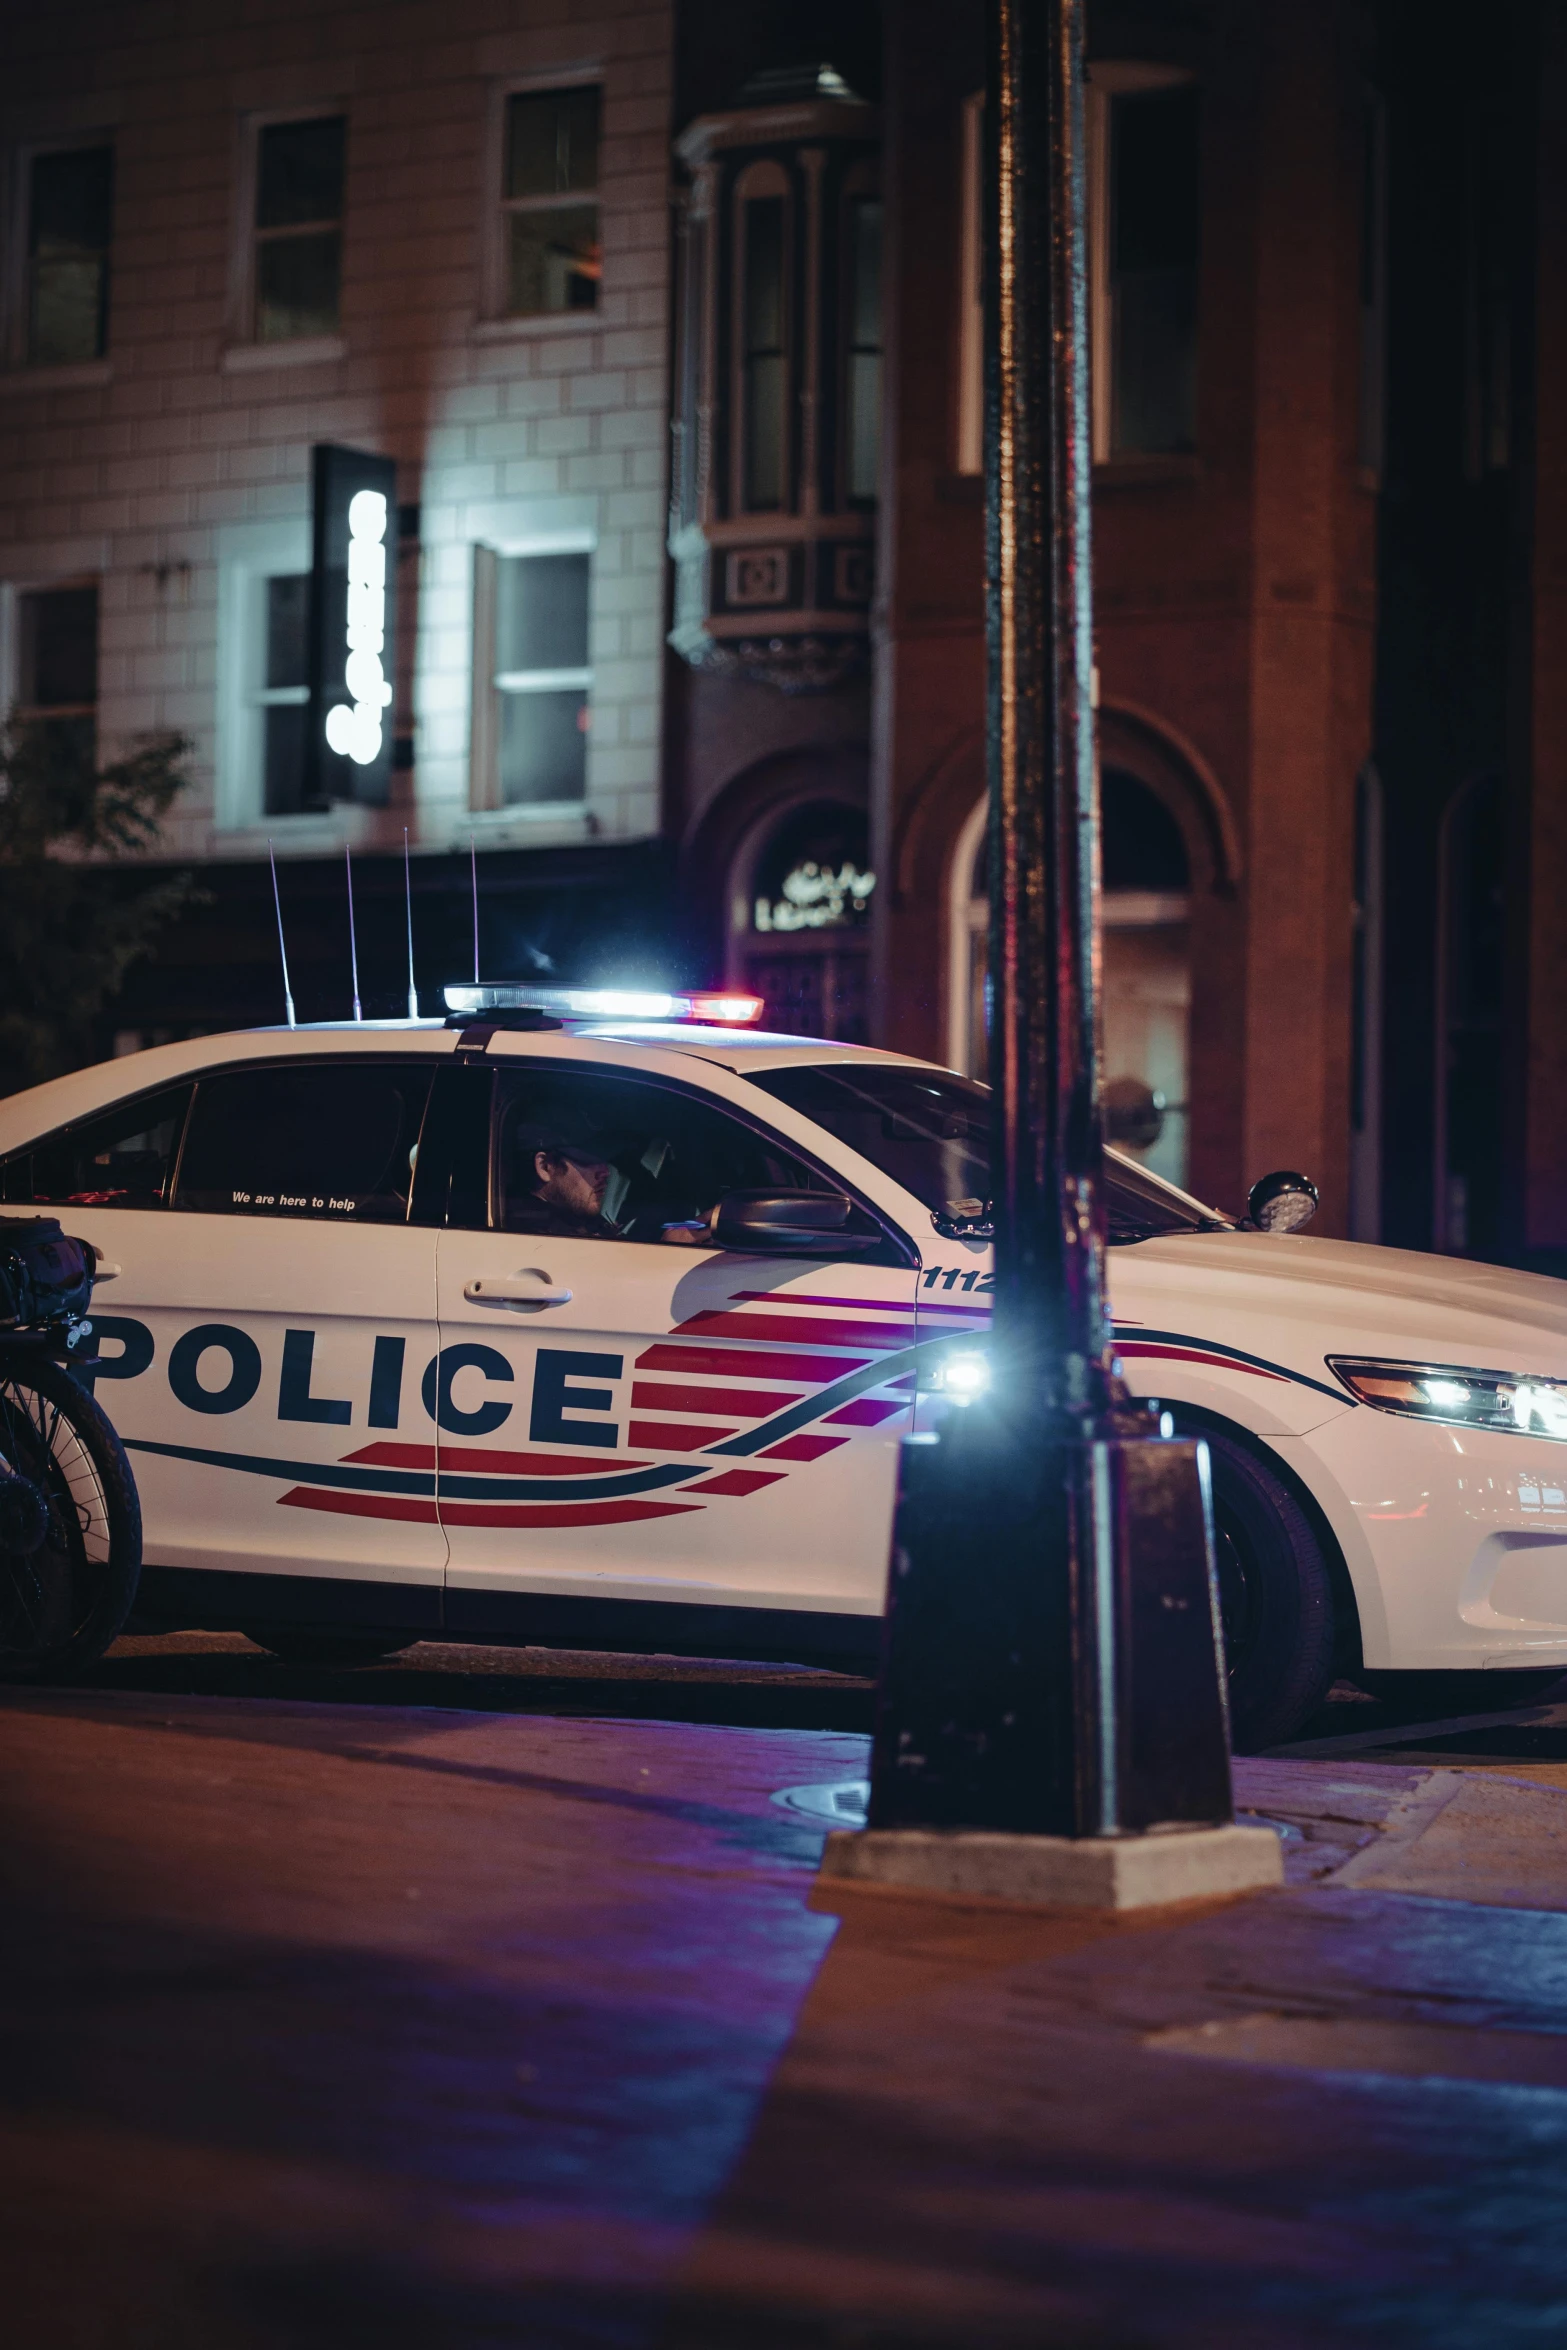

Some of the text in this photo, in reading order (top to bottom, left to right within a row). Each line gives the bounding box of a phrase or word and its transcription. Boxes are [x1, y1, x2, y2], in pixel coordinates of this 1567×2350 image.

[232, 1191, 355, 1212] We are here to help
[72, 1313, 624, 1449] POLICE
